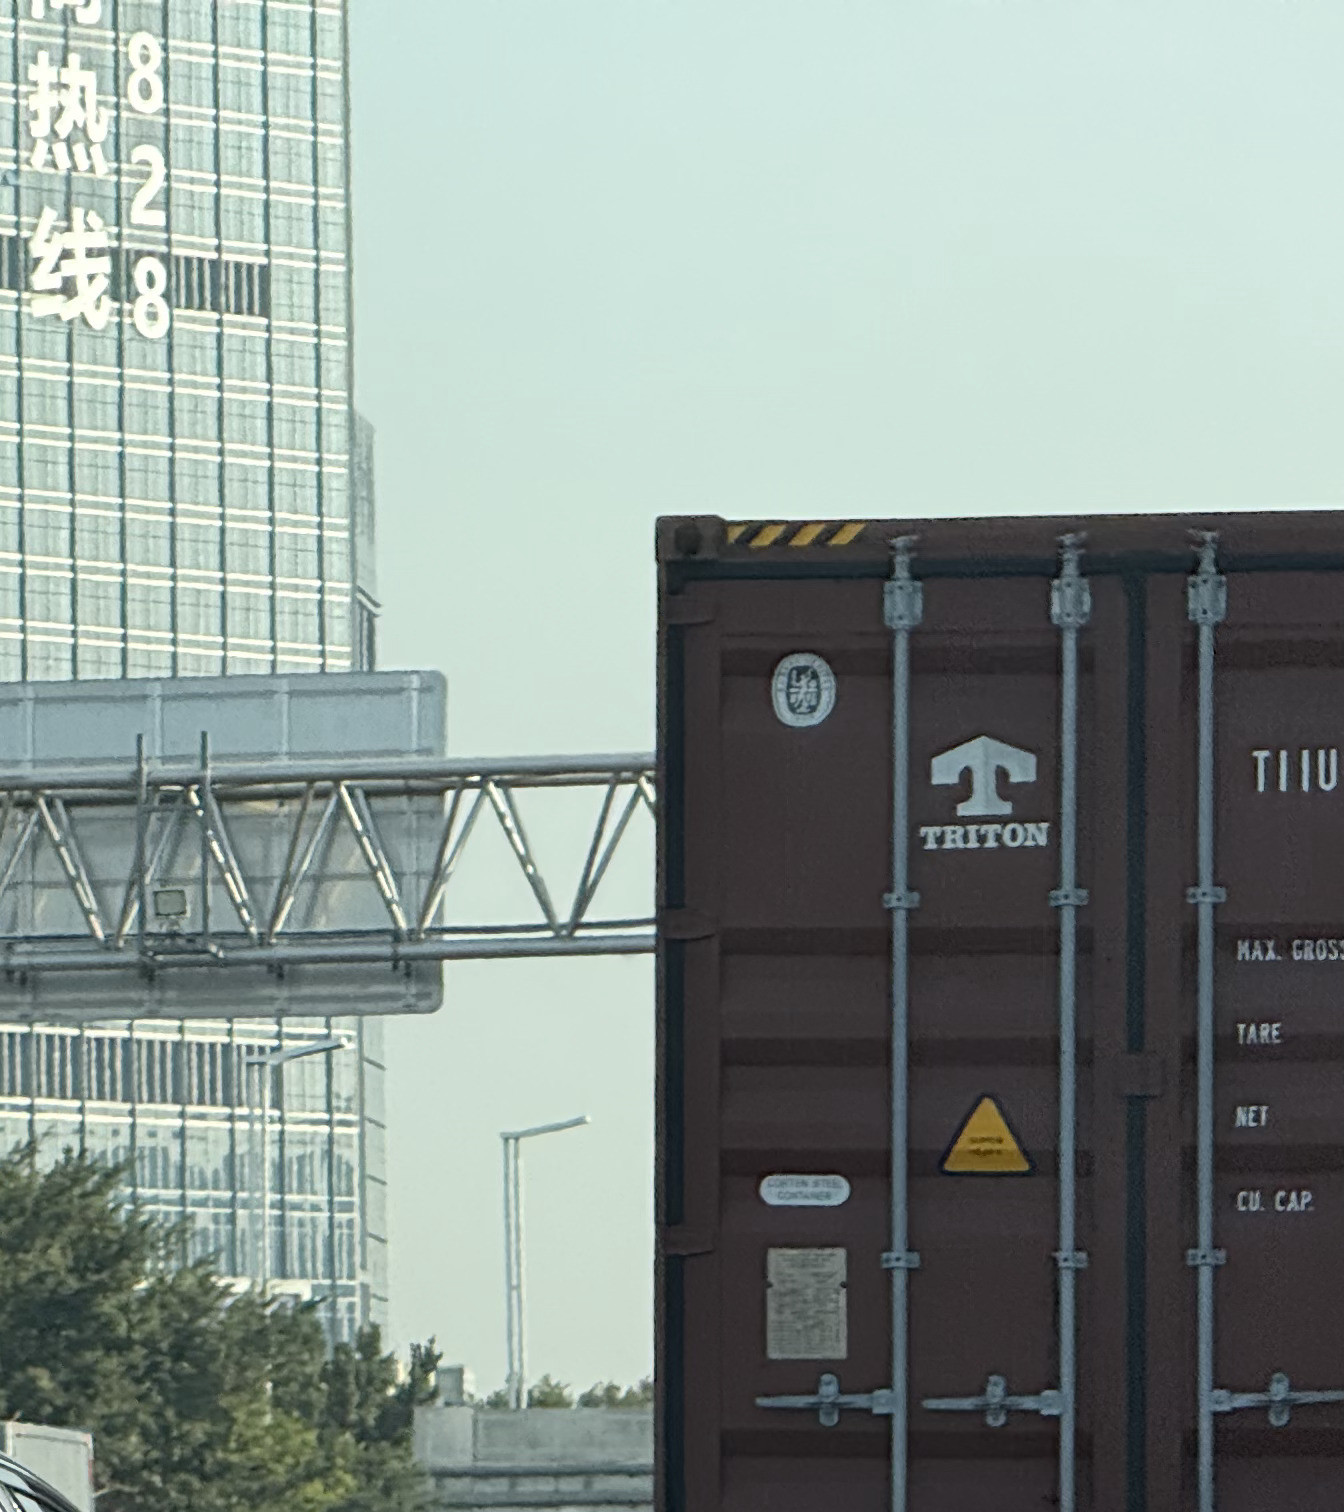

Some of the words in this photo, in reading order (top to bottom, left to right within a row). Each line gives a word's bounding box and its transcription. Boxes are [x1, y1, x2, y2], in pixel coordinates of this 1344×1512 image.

[28, 0, 111, 331] 热线
[1252, 748, 1339, 793] TIIU
[919, 822, 1051, 850] TRITON
[1237, 939, 1282, 961] MAX.
[1237, 1022, 1282, 1045] TARE
[1234, 1105, 1269, 1128] NET
[1236, 1190, 1265, 1212] CU.
[1274, 1190, 1315, 1212] CAP.
